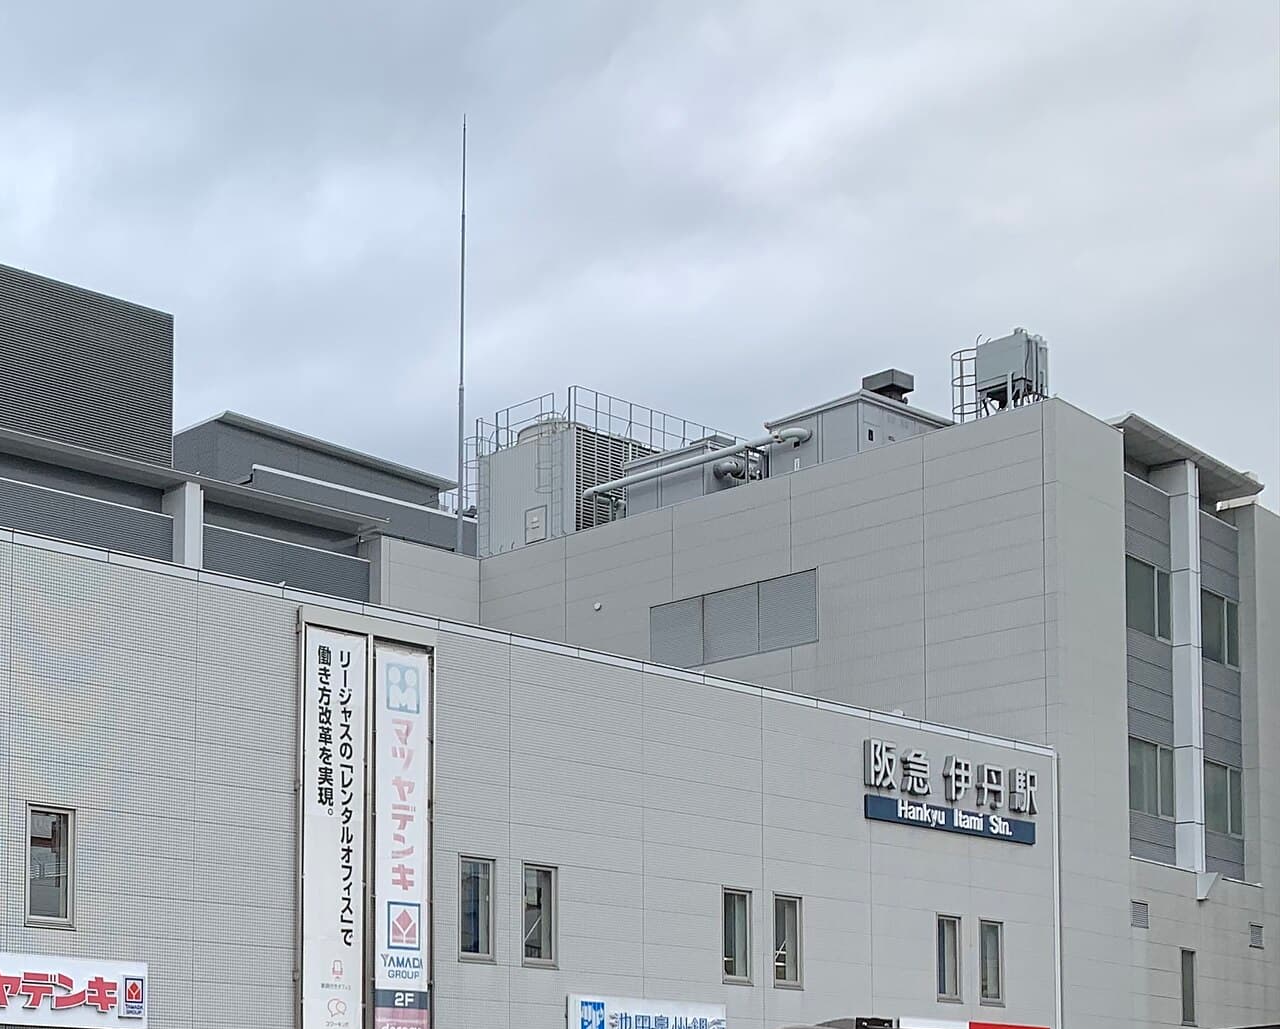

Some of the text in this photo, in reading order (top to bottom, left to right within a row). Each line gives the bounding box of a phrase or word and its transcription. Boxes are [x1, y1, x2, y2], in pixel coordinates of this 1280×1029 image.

[317, 645, 334, 817] 働き方改革を実現。
[338, 649, 355, 947] リージャスの「レンタルオフィス」で
[391, 717, 416, 892] マツヤデンキ
[865, 738, 1039, 815] 阪急 伊丹駅
[897, 798, 1013, 836] Hankyu Itami Stn.
[388, 969, 420, 980] GROUP
[394, 991, 415, 1007] 2F
